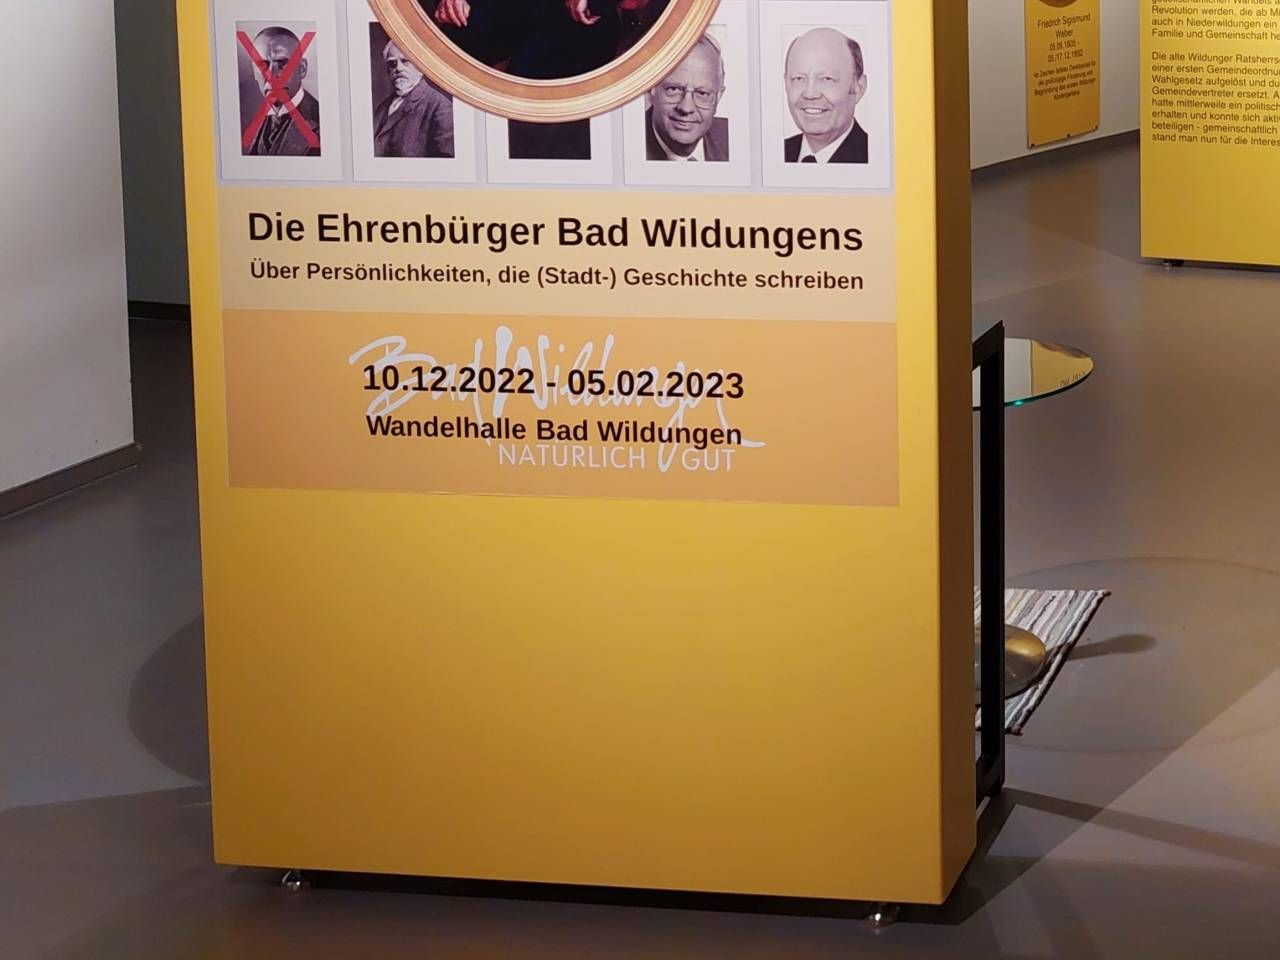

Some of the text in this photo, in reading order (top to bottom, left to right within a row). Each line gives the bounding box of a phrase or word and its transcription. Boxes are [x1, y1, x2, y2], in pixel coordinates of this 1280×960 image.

[1151, 51, 1167, 61] Die
[1168, 52, 1186, 61] alte
[1187, 52, 1233, 64] Wildunger
[1151, 63, 1174, 72] einer
[1175, 65, 1205, 73] ersten
[1151, 74, 1203, 86] Wahlgesetz
[1205, 76, 1247, 88] aufgelöst
[1248, 78, 1266, 87] und
[1151, 86, 1234, 97] Gemeindevertreter
[1236, 90, 1270, 99] ersetzt.
[1151, 97, 1174, 107] hatte
[1176, 99, 1227, 109] mittlerweile
[1228, 101, 1243, 110] ein
[1151, 109, 1188, 119] erhalten
[1189, 110, 1207, 120] und
[1208, 111, 1240, 121] konnte
[1241, 112, 1261, 122] sich
[1151, 121, 1195, 132] beteiligen
[1202, 124, 1278, 134] gemeinschaftlich
[1151, 132, 1177, 142] stand
[1178, 134, 1198, 142] man
[1200, 135, 1218, 143] nun
[1219, 135, 1232, 144] für
[1233, 135, 1248, 145] die
[248, 212, 863, 255] Die Ehrenbürger Bad Wildungens
[250, 258, 863, 289] Über Persönlichkeiten, die (Stadt-) Geschichte schreiben
[363, 365, 535, 393] 10.12.2022
[567, 369, 744, 398] 05.02.2023
[365, 415, 742, 449] Wandelhalle Bad Wildungen
[682, 449, 735, 472] GUT
